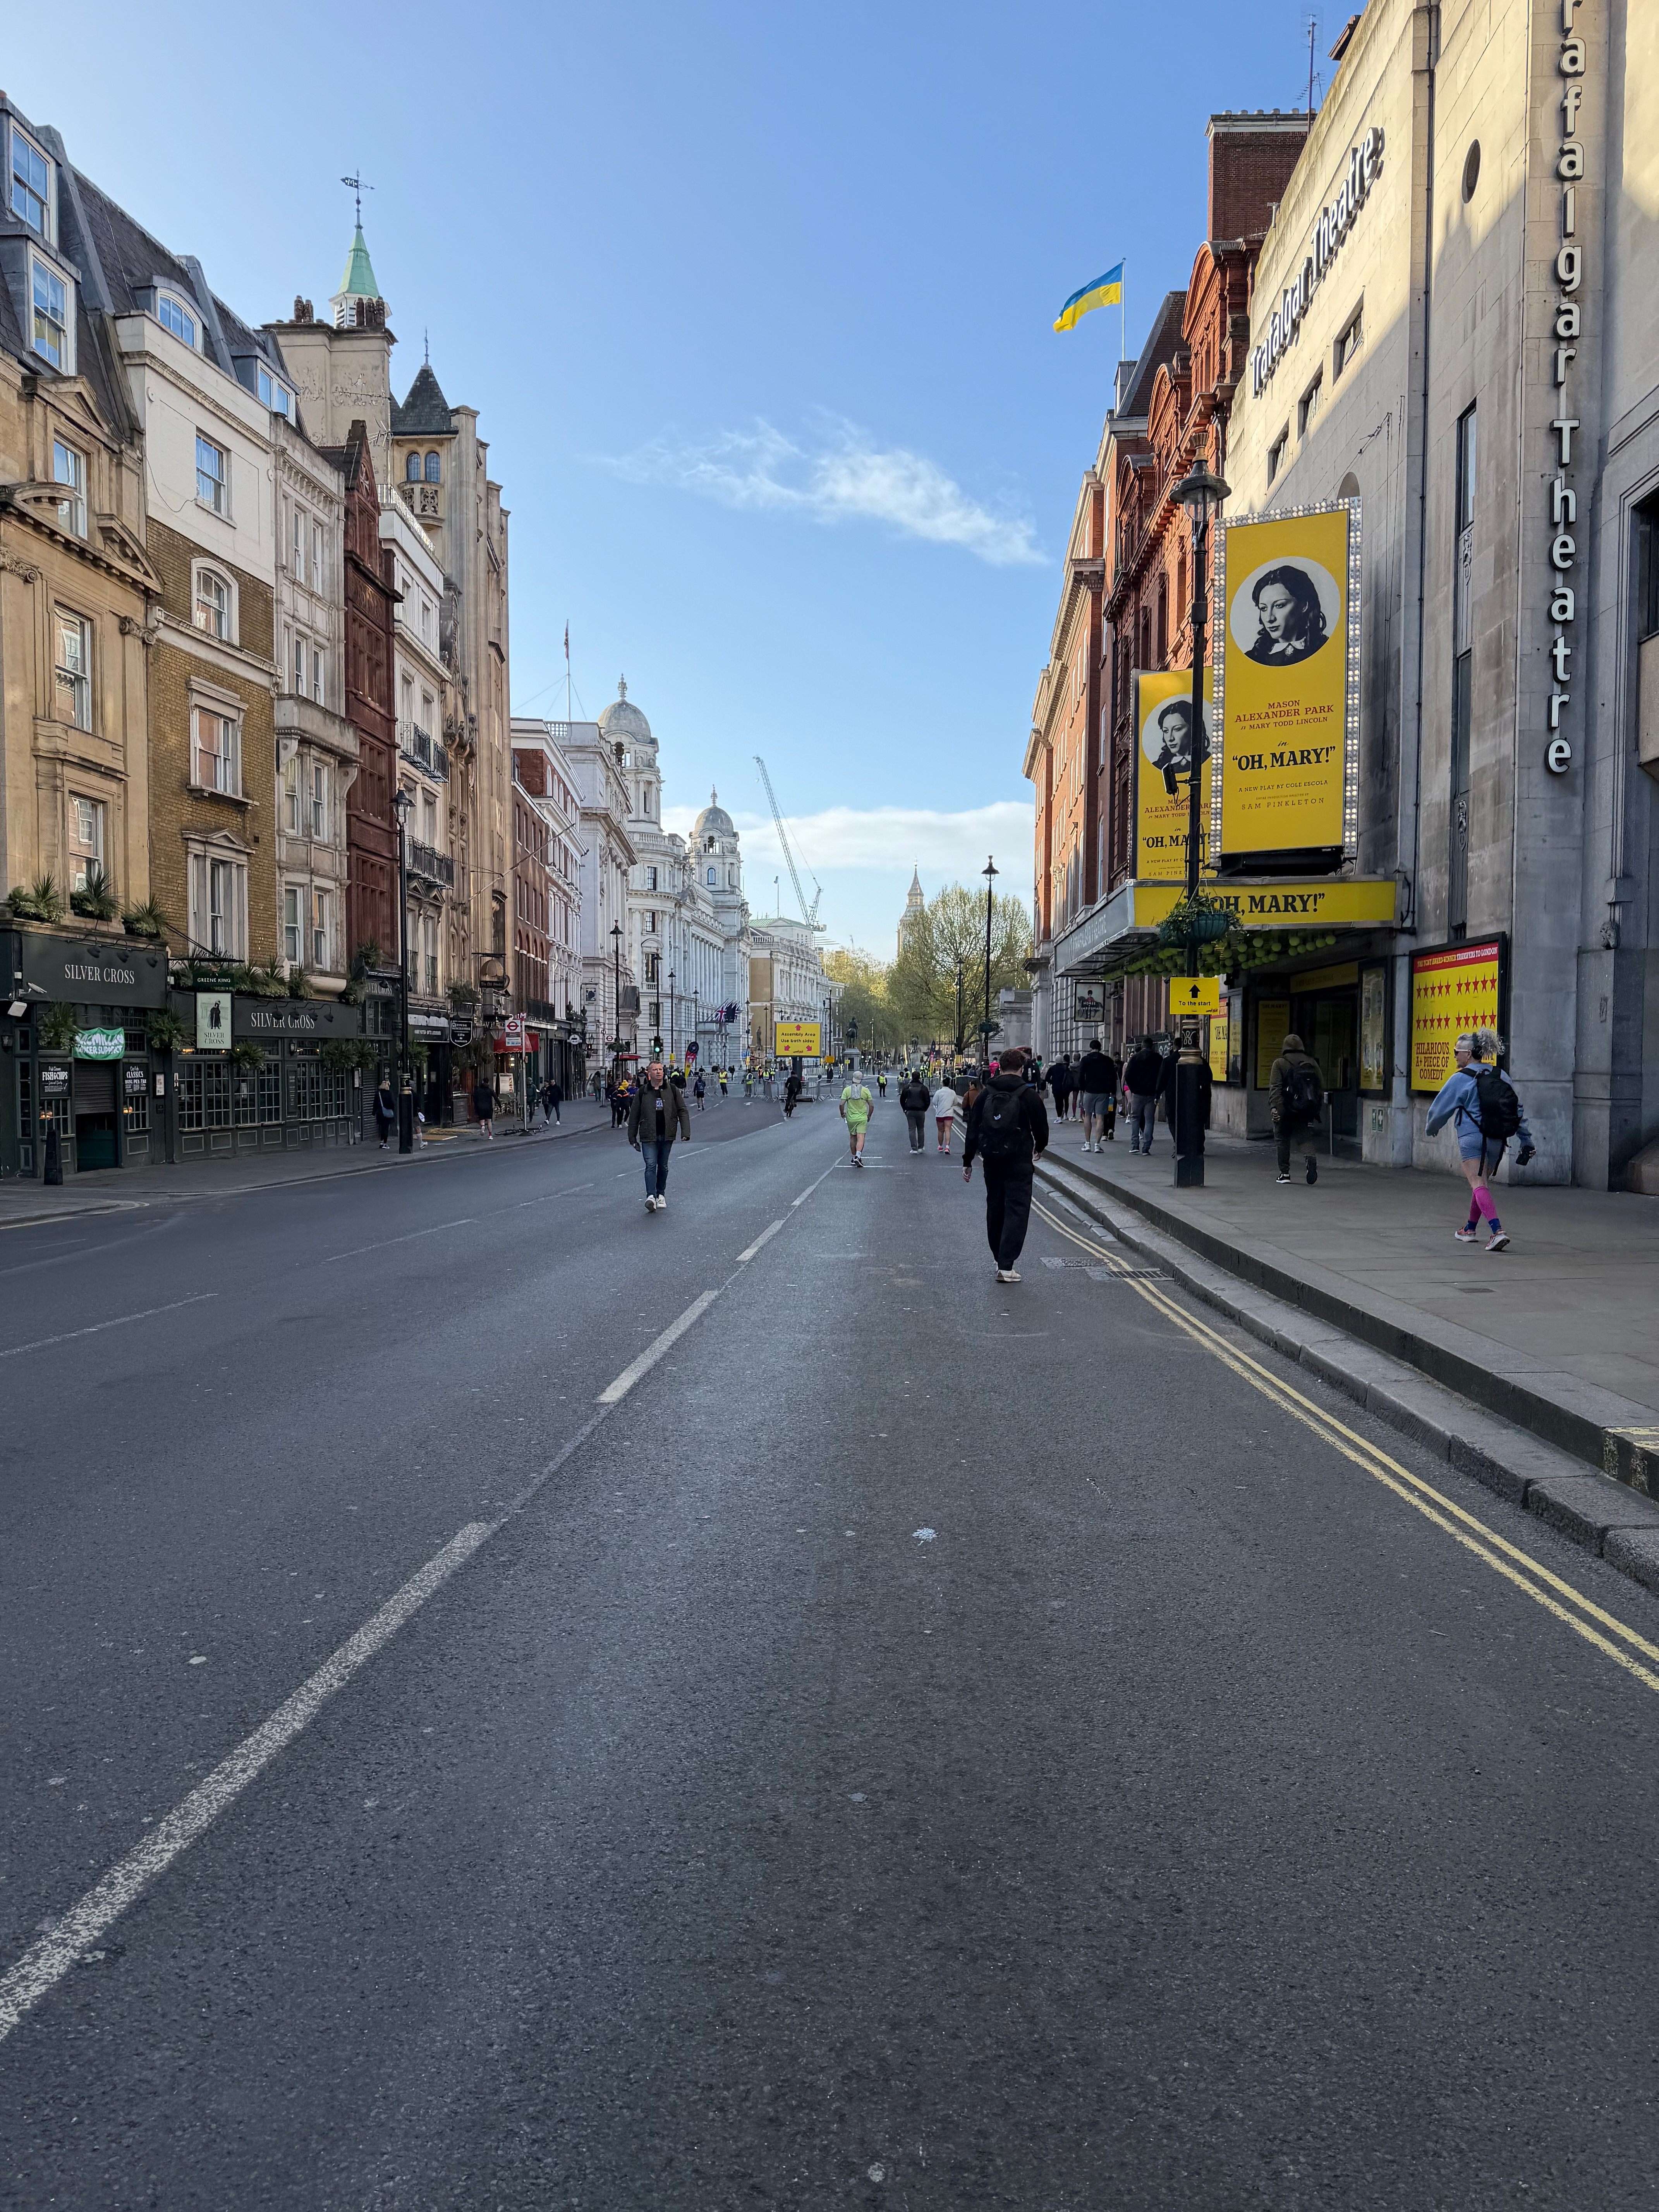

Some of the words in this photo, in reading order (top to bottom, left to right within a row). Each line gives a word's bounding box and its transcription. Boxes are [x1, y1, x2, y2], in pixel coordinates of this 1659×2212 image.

[1250, 256, 1313, 399] Trafalgar
[1309, 127, 1379, 287] Theatre
[1545, 419, 1580, 774] Theatre
[1268, 700, 1300, 709] MASON
[1235, 709, 1300, 723] ALEXANDER
[1305, 704, 1334, 715] PARK
[1297, 717, 1328, 725] LINCOLN
[1232, 754, 1267, 771] "OH,
[1270, 746, 1336, 768] MARY!"
[1267, 798, 1324, 808] PINKLETON
[1247, 893, 1325, 913] MARY!"
[1456, 951, 1475, 960] TRANSFERS
[1476, 950, 1481, 958] TO
[1481, 947, 1498, 956] LONDON
[65, 964, 101, 981] SILVER
[104, 968, 134, 984] CROSS
[251, 1013, 285, 1028] SILVER
[288, 1015, 314, 1029] CROSS
[1424, 1056, 1440, 1067] PIECE
[1441, 1056, 1449, 1067] OF
[42, 1072, 53, 1081] FISH
